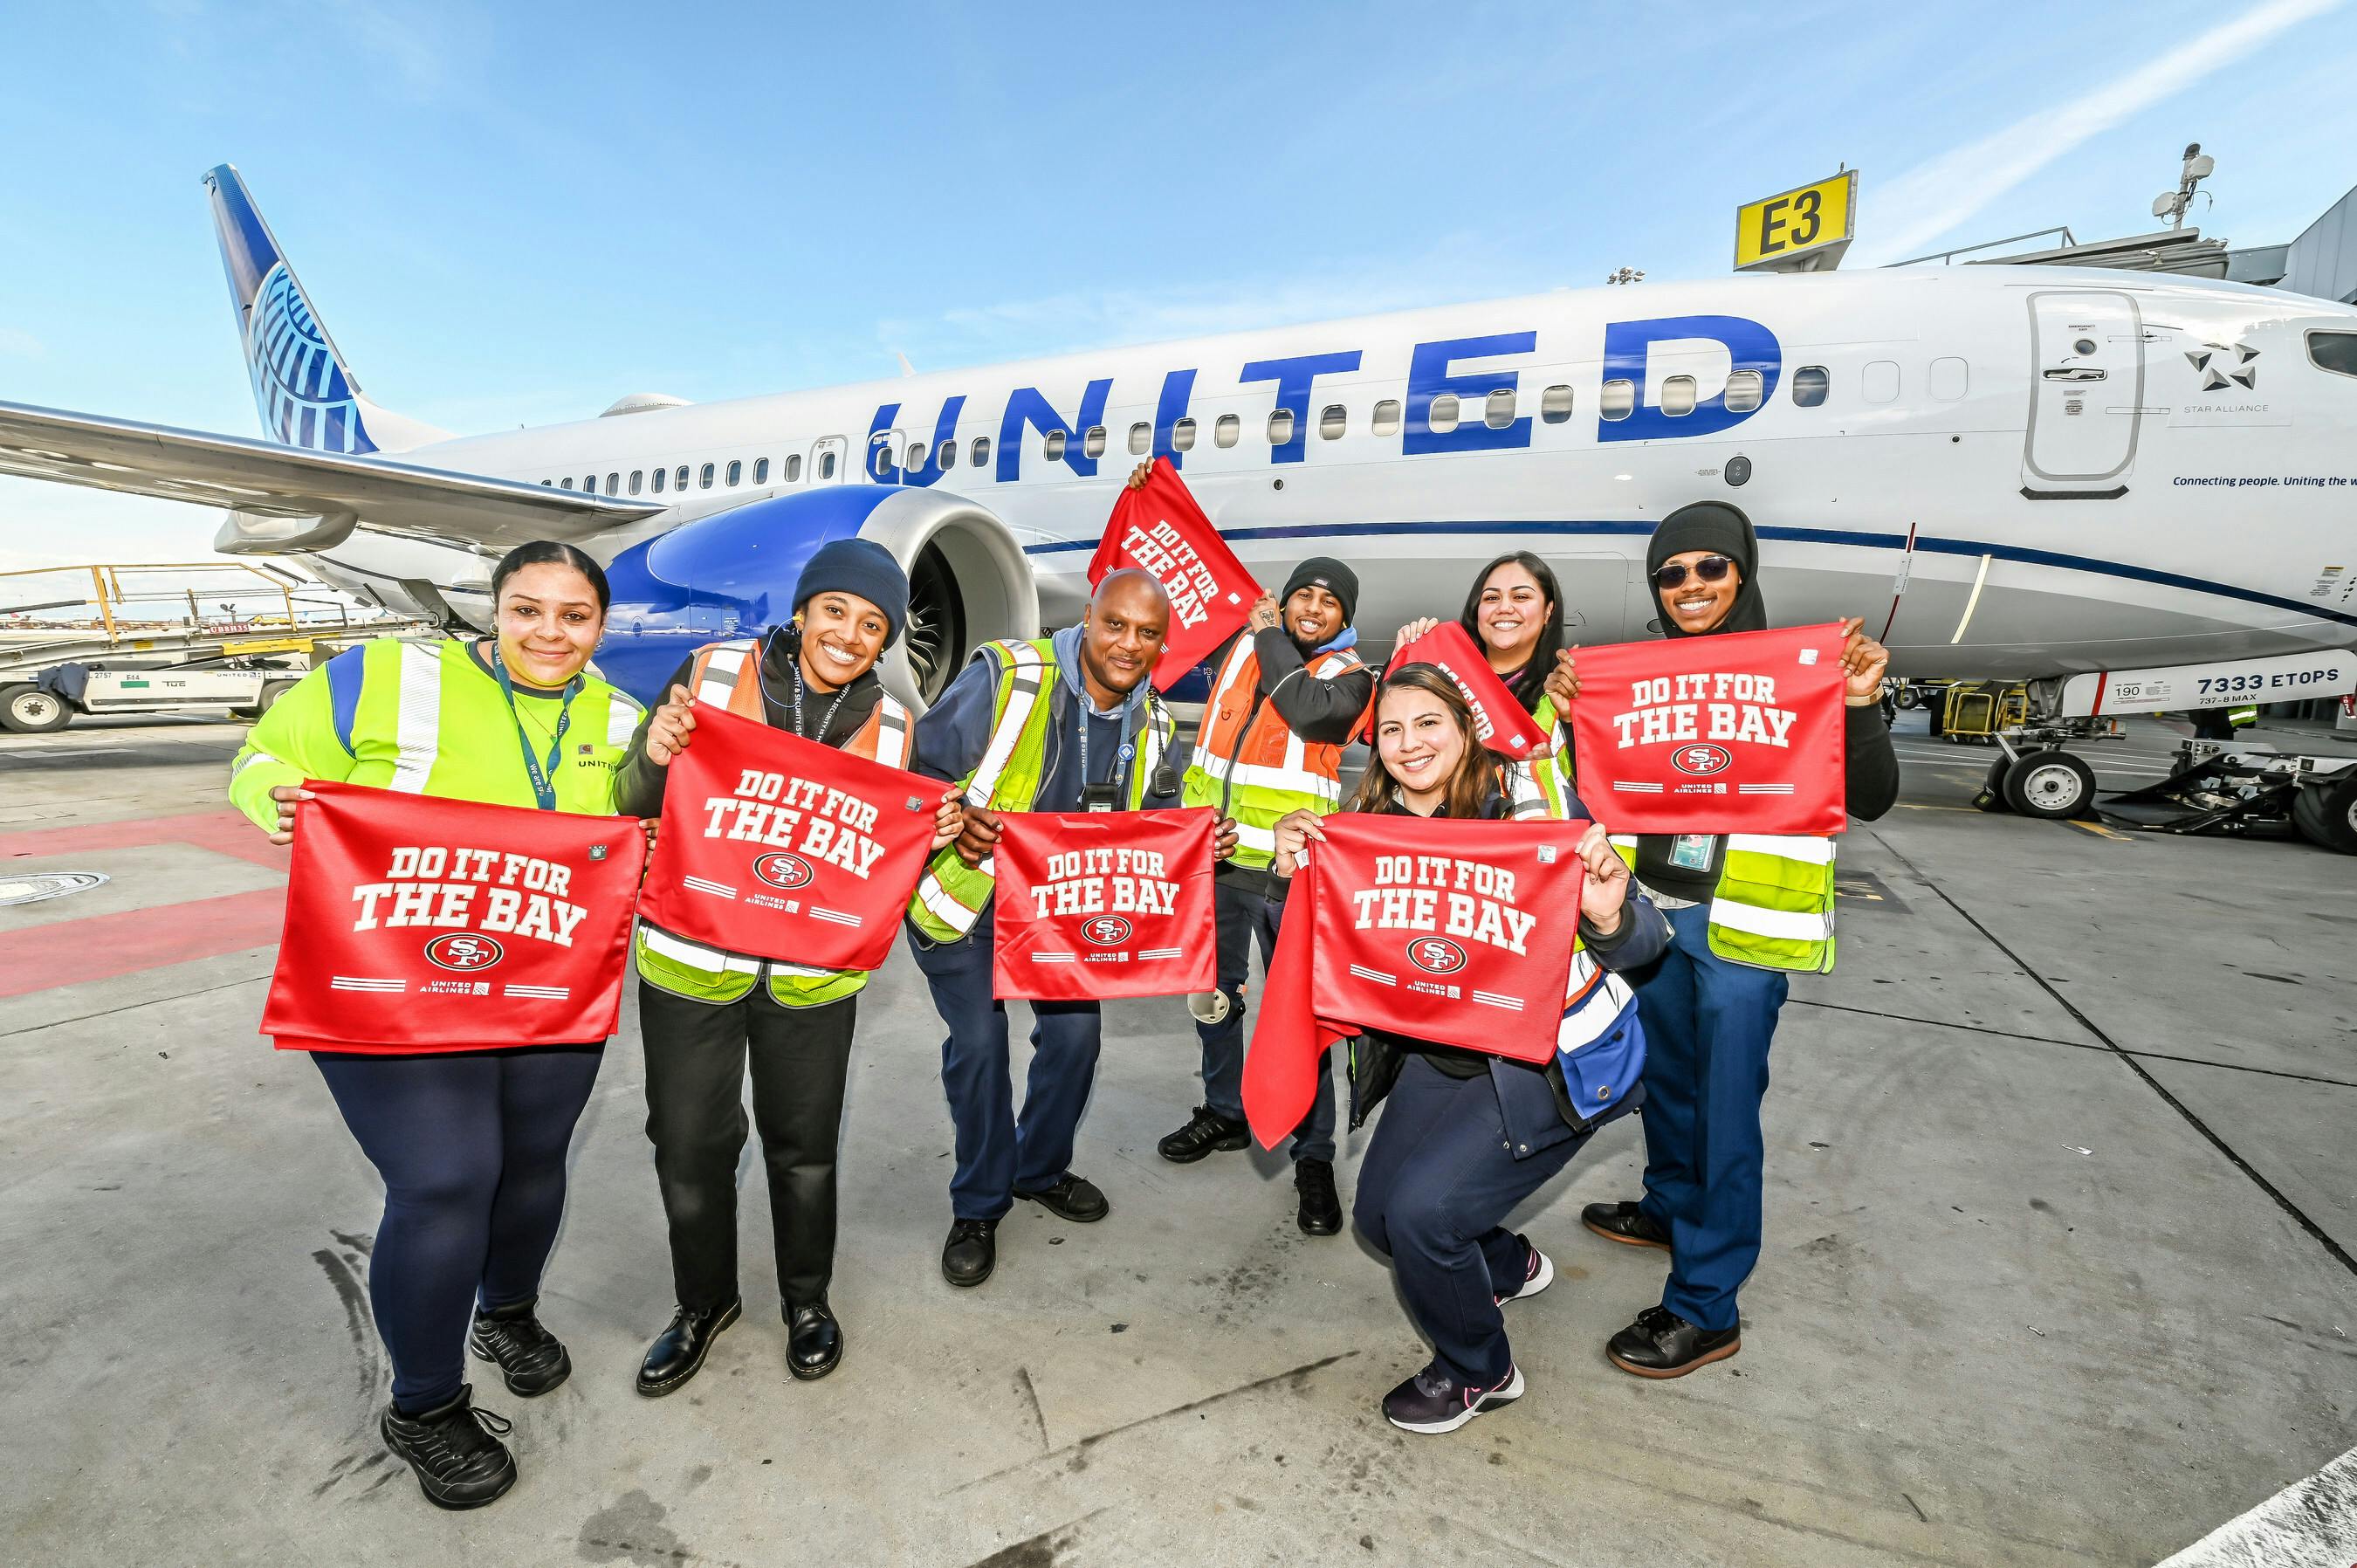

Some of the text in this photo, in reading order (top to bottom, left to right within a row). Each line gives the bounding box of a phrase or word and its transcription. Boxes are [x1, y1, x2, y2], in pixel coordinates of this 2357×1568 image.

[1760, 189, 1821, 256] E3
[865, 314, 1782, 486] UNITED
[2184, 404, 2269, 414] STAR ALLIANCE
[2173, 476, 2237, 486] Connecting
[2238, 476, 2280, 487] people.
[2284, 476, 2325, 487] Uniting
[2328, 476, 2347, 486] the
[1120, 525, 1208, 630] THE BAY
[1149, 519, 1220, 604] DO IT FOR
[1632, 673, 1776, 708] DO IT FOR
[2115, 686, 2140, 697] 190
[2197, 669, 2339, 695] 7333 ETOPS
[2199, 693, 2257, 705] 737-8 MAX
[821, 702, 839, 729] SECURITY
[1612, 703, 1797, 750] THE BAY
[529, 763, 538, 774] We
[533, 775, 542, 786] are
[733, 768, 879, 835] DO IT FOR
[704, 796, 886, 881] THE BAY
[386, 847, 572, 898] DO IT FOR
[1047, 848, 1166, 883] DO IT FOR
[1374, 856, 1516, 904] DO IT FOR
[352, 882, 588, 948] THE BAY
[745, 897, 785, 910] AIRLINES
[754, 894, 786, 904] UNITED
[1030, 876, 1180, 919] THE BAY
[1353, 888, 1537, 958] THE BAY
[419, 986, 471, 994] AIRLINES
[1406, 984, 1446, 997] AIRLINES
[1414, 980, 1446, 991] UNITED
